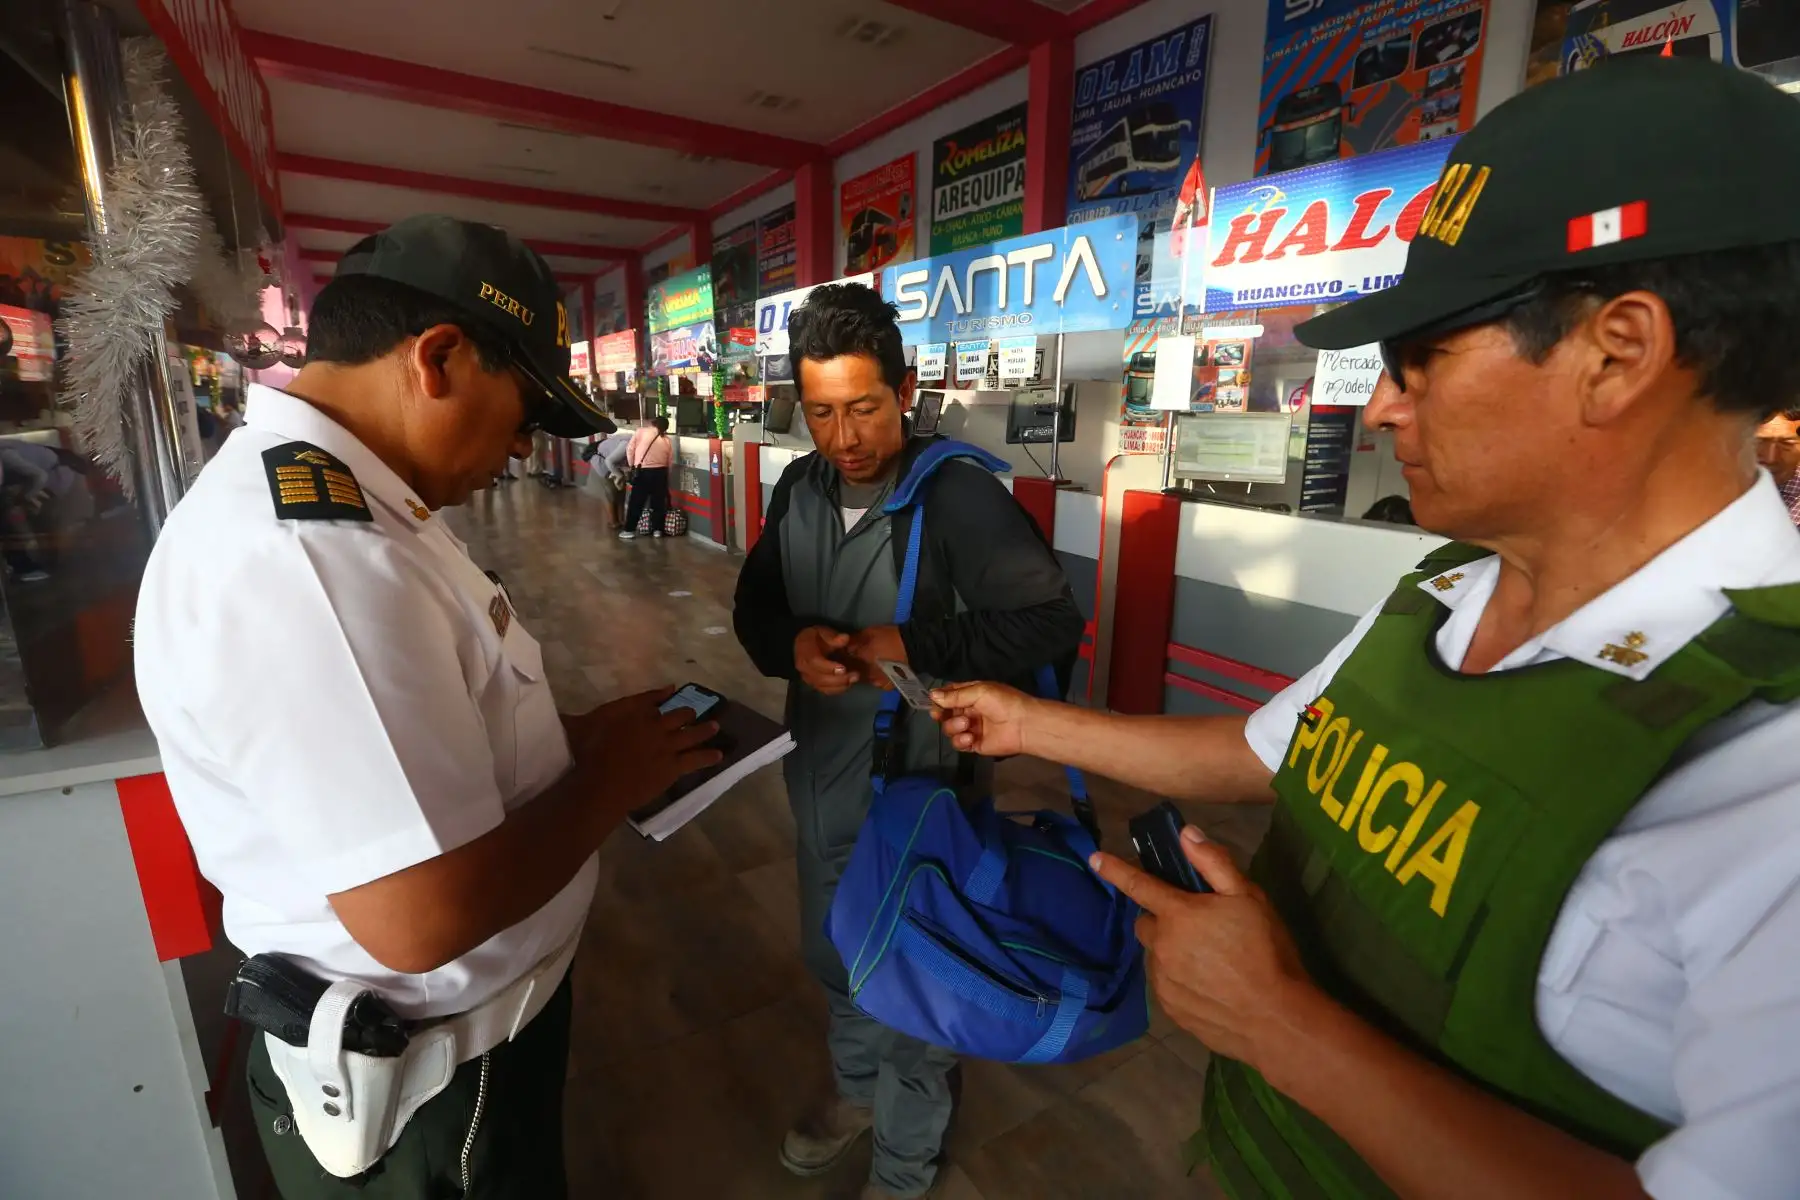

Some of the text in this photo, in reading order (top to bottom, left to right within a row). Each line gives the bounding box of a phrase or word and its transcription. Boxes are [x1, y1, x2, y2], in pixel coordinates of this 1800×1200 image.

[1076, 32, 1186, 108] OLAM
[1074, 108, 1095, 123] LIMA
[1139, 69, 1201, 98] HUANCAYO
[940, 126, 1025, 176] ROMELIZA
[938, 161, 1026, 216] AREQUIPA
[478, 281, 535, 326] PERU
[895, 236, 1107, 322] SANTA
[1237, 279, 1343, 301] HUANCAYO
[946, 312, 1033, 333] TURISMO
[1322, 351, 1382, 371] Mercado
[1323, 377, 1375, 402] Modelo
[1288, 697, 1481, 918] POLICIA
